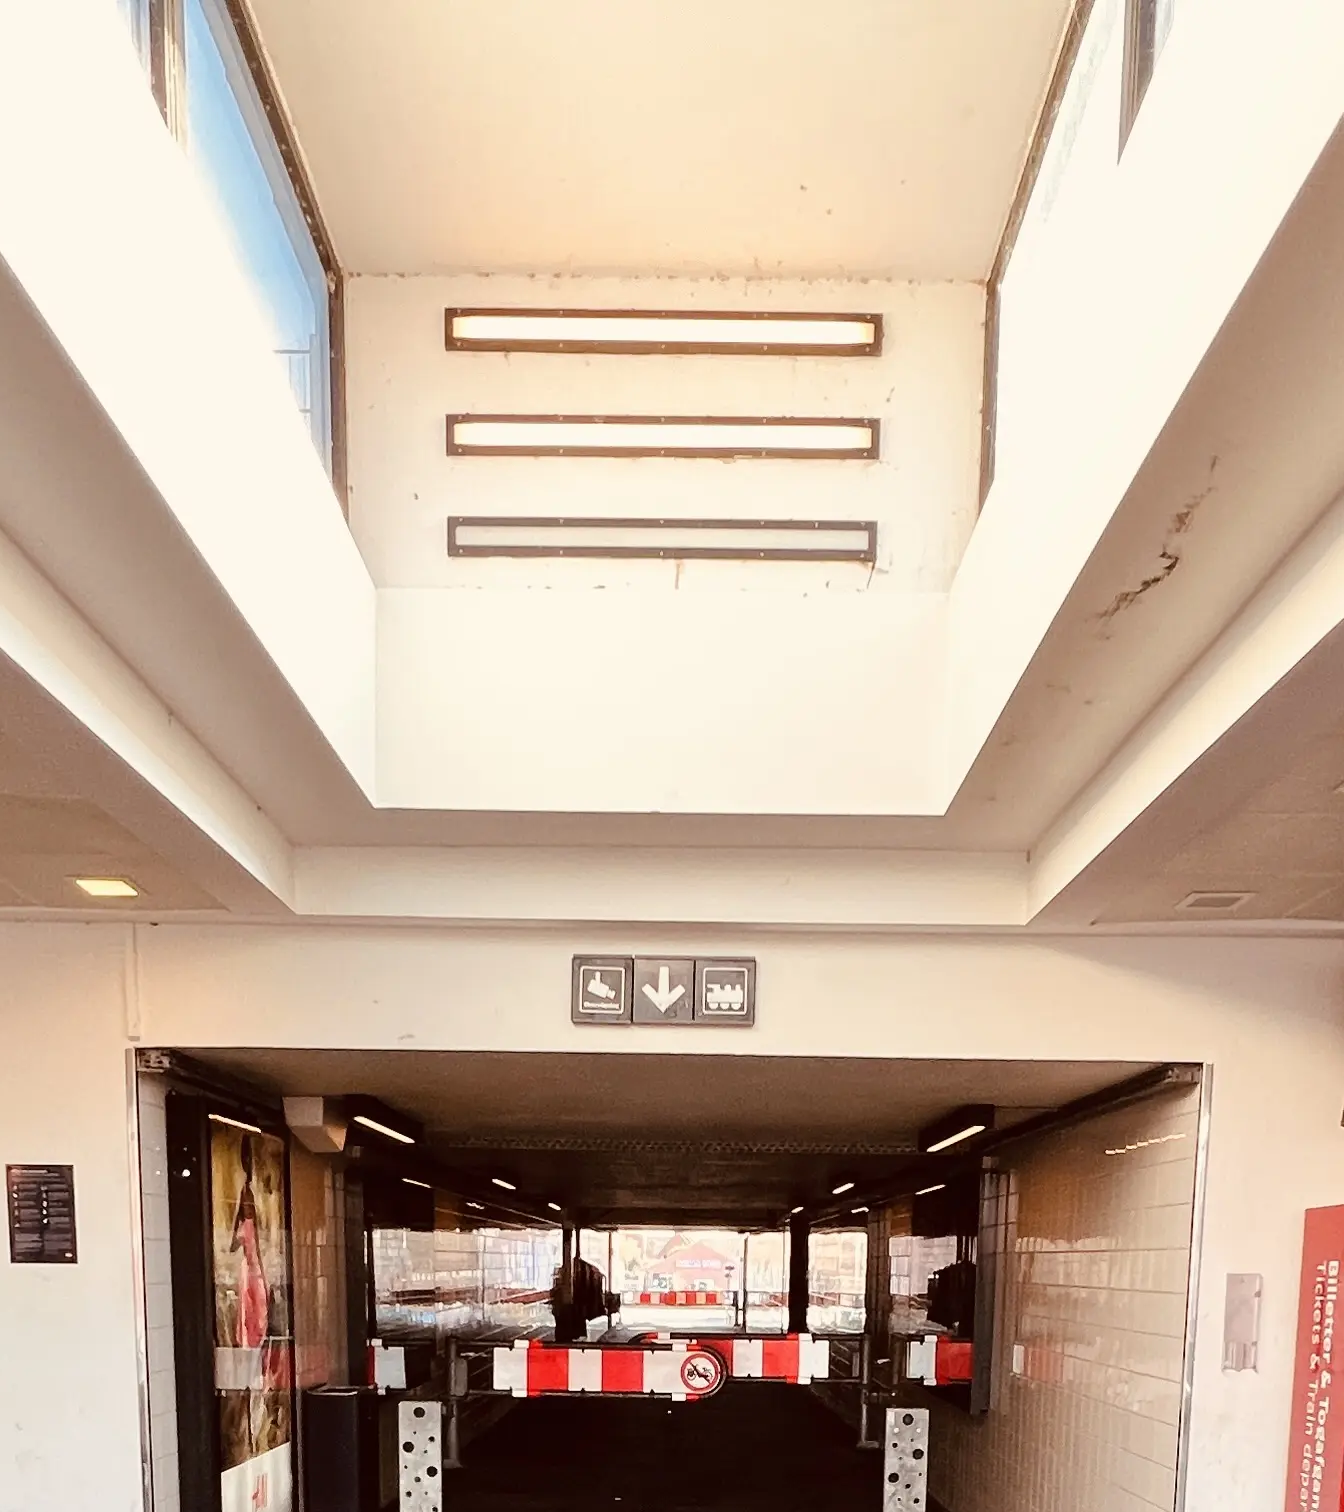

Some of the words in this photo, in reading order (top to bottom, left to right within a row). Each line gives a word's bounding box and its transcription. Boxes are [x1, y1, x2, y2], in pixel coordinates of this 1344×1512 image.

[1311, 1260, 1327, 1345] Tickets
[1322, 1260, 1339, 1364] Billetter
[1309, 1353, 1320, 1370] &
[1320, 1370, 1331, 1389] &
[1304, 1380, 1319, 1435] Train
